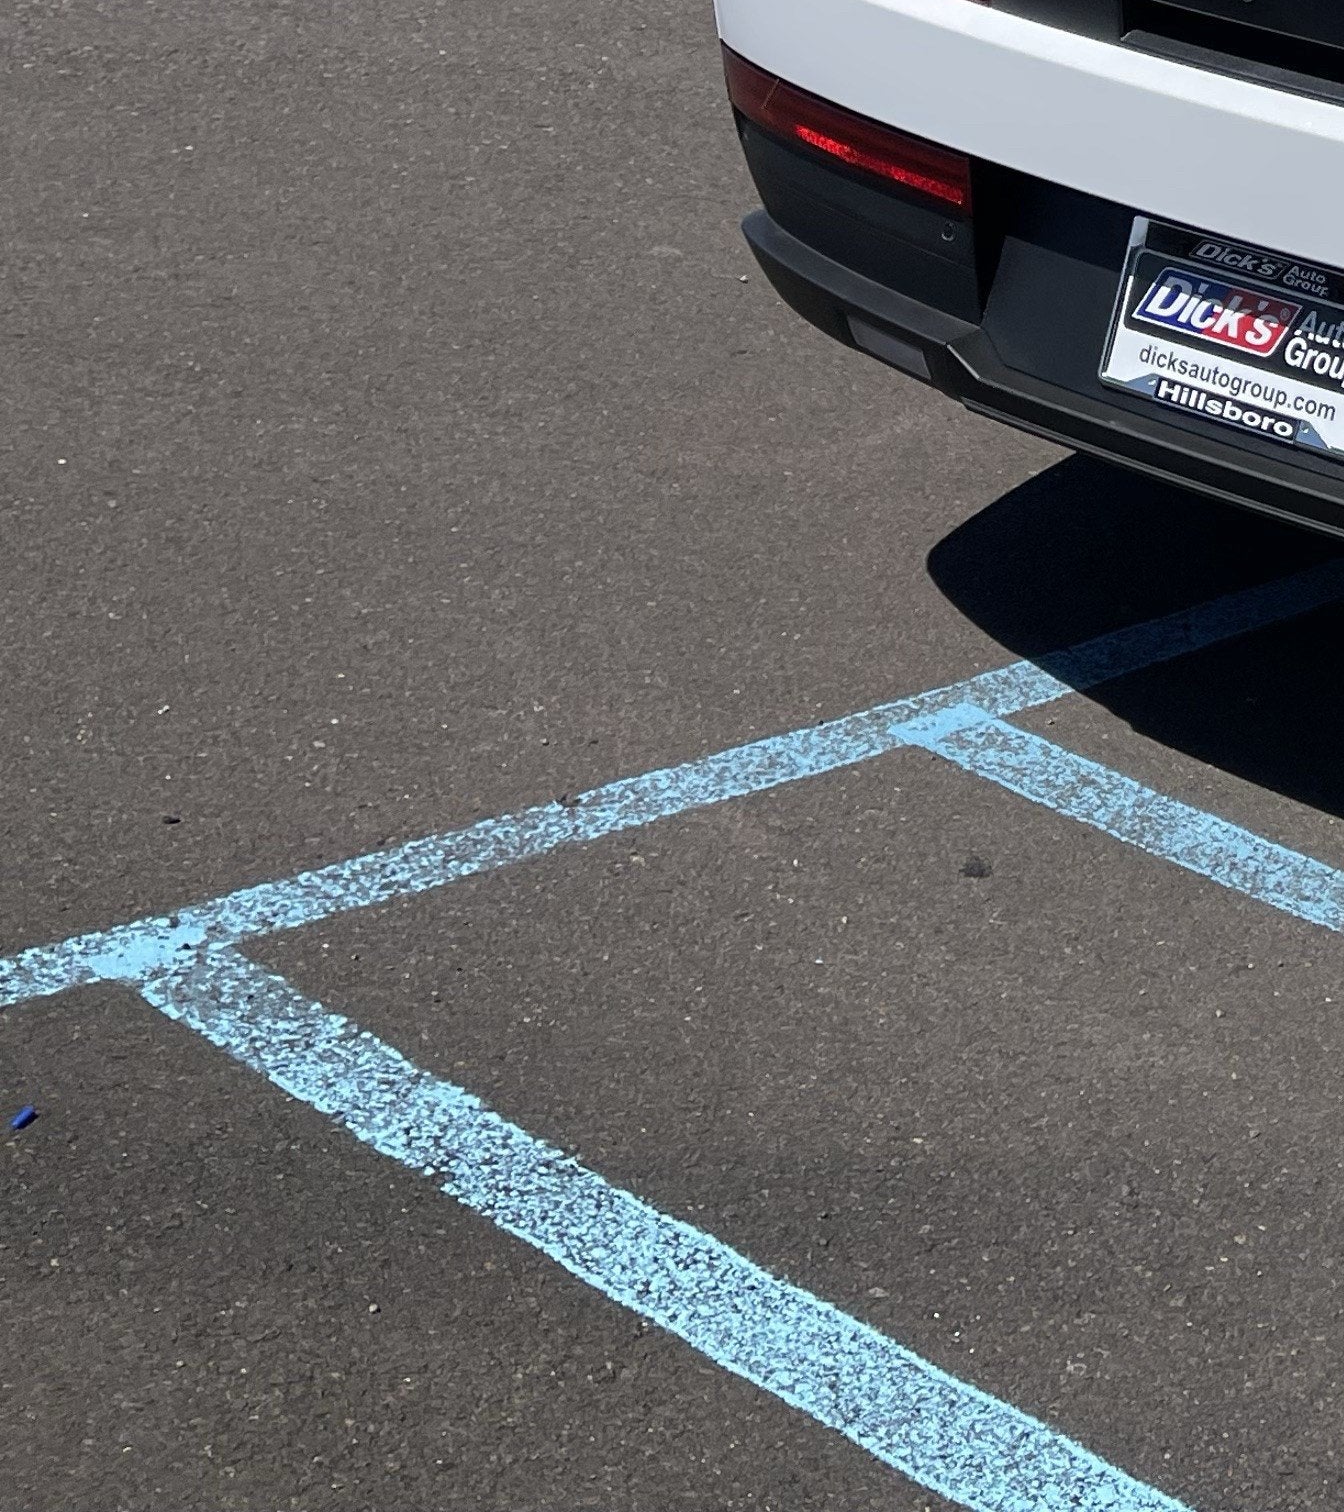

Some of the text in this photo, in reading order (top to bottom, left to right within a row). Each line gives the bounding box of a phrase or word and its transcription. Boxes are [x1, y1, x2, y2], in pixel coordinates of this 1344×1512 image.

[1195, 243, 1277, 275] Dick's
[1290, 265, 1326, 284] Auto
[1145, 276, 1281, 346] Dick's
[1138, 343, 1337, 422] dicksautogroup.com
[1157, 380, 1294, 438] Hillsboro
